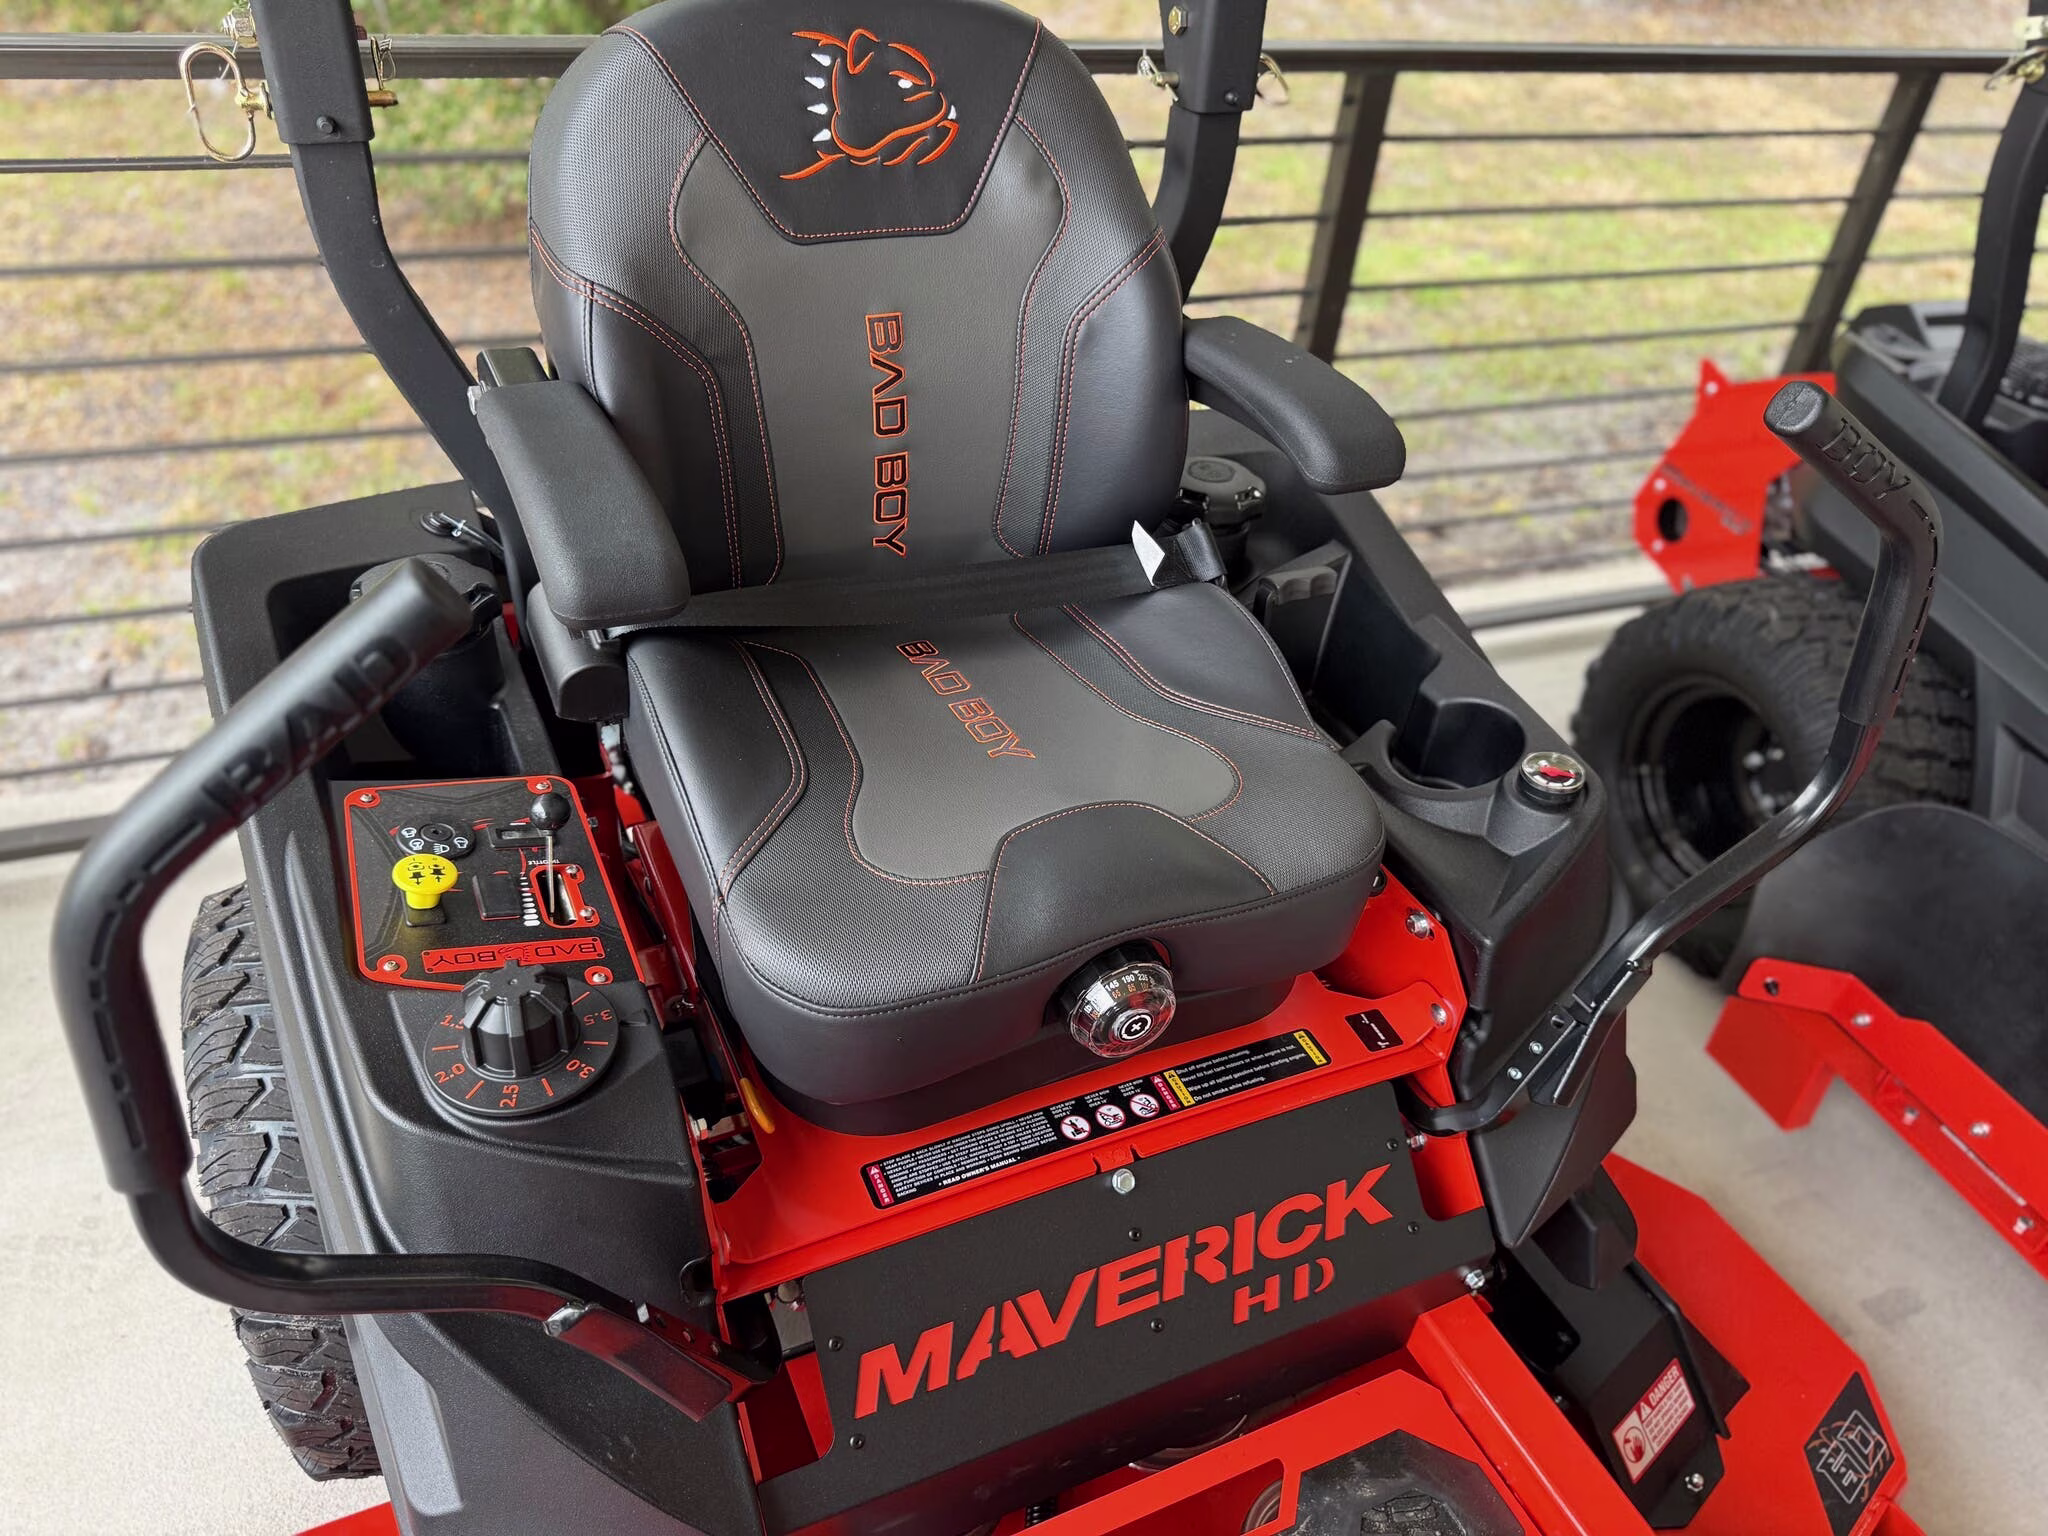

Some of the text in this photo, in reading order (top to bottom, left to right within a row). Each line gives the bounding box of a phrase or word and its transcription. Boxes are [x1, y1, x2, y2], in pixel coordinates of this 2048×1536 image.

[866, 312, 908, 557] BAD BOY
[896, 640, 1036, 758] BAD BOY
[432, 943, 598, 967] BAD BOY
[1105, 980, 1120, 992] 145
[583, 1009, 612, 1026] 3.5
[434, 1063, 466, 1085] 2.0
[566, 1060, 595, 1079] 3.0
[500, 1084, 520, 1108] 2.5
[1158, 1083, 1177, 1108] DANGER
[943, 1157, 1016, 1185] READ OWNER'S MANUAL
[874, 1174, 890, 1203] DANGER
[854, 1163, 1394, 1419] MAVERICK
[1233, 1257, 1335, 1325] HD
[1648, 1365, 1680, 1404] DANGER
